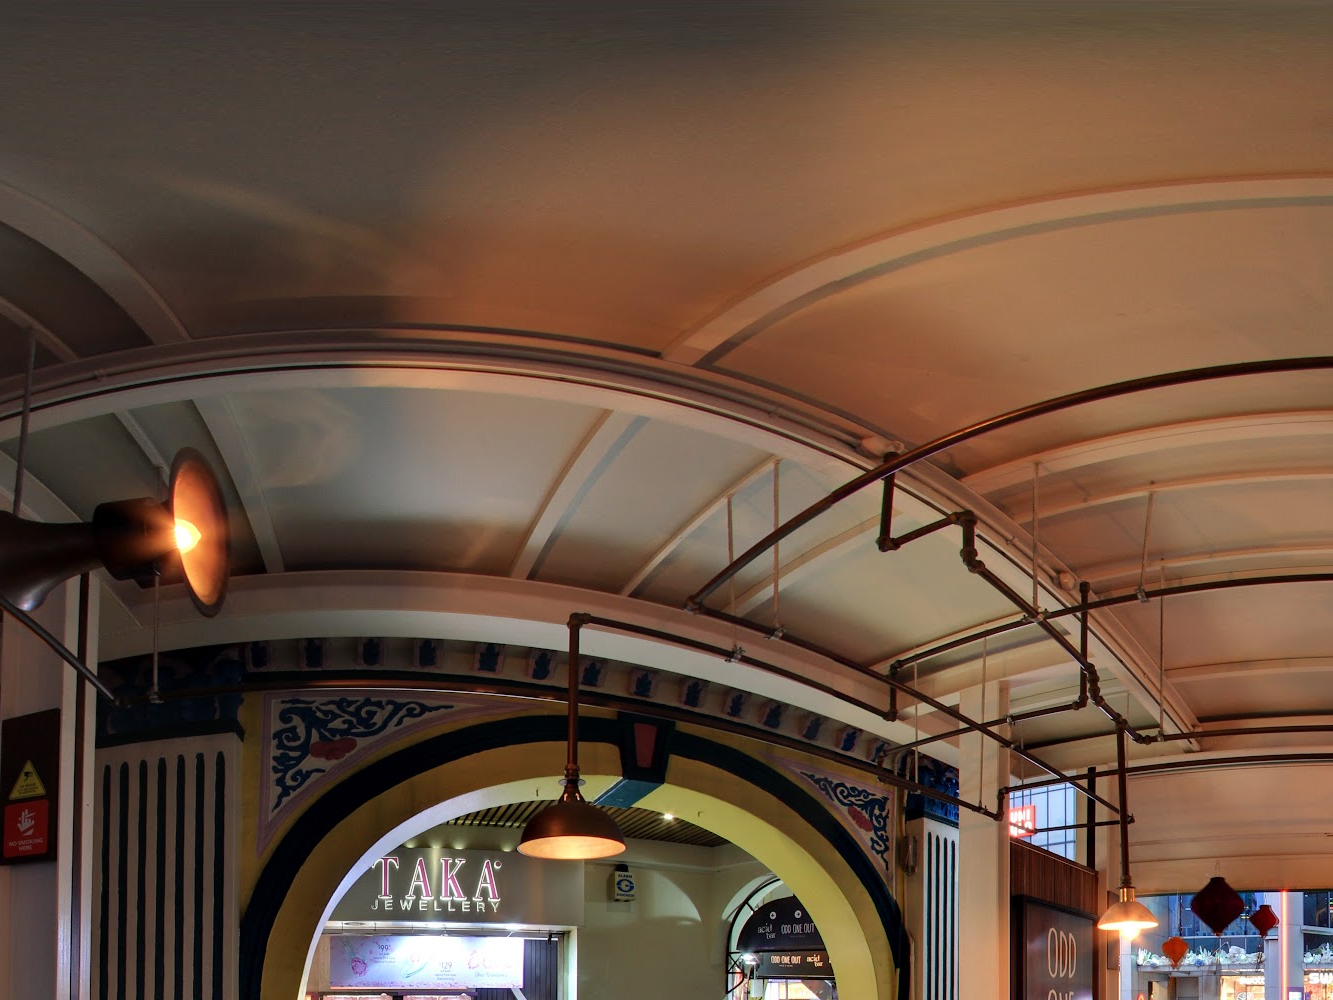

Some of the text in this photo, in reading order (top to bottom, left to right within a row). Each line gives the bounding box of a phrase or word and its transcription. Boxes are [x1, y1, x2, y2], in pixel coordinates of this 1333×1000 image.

[18, 838, 43, 846] SMOKING
[371, 857, 502, 901] TAKA
[371, 899, 500, 912] JEWELLERY
[758, 923, 815, 934] acid ODD ONE OUT
[770, 954, 820, 964] ODD ONE OUT acid
[1047, 927, 1077, 979] ODD
